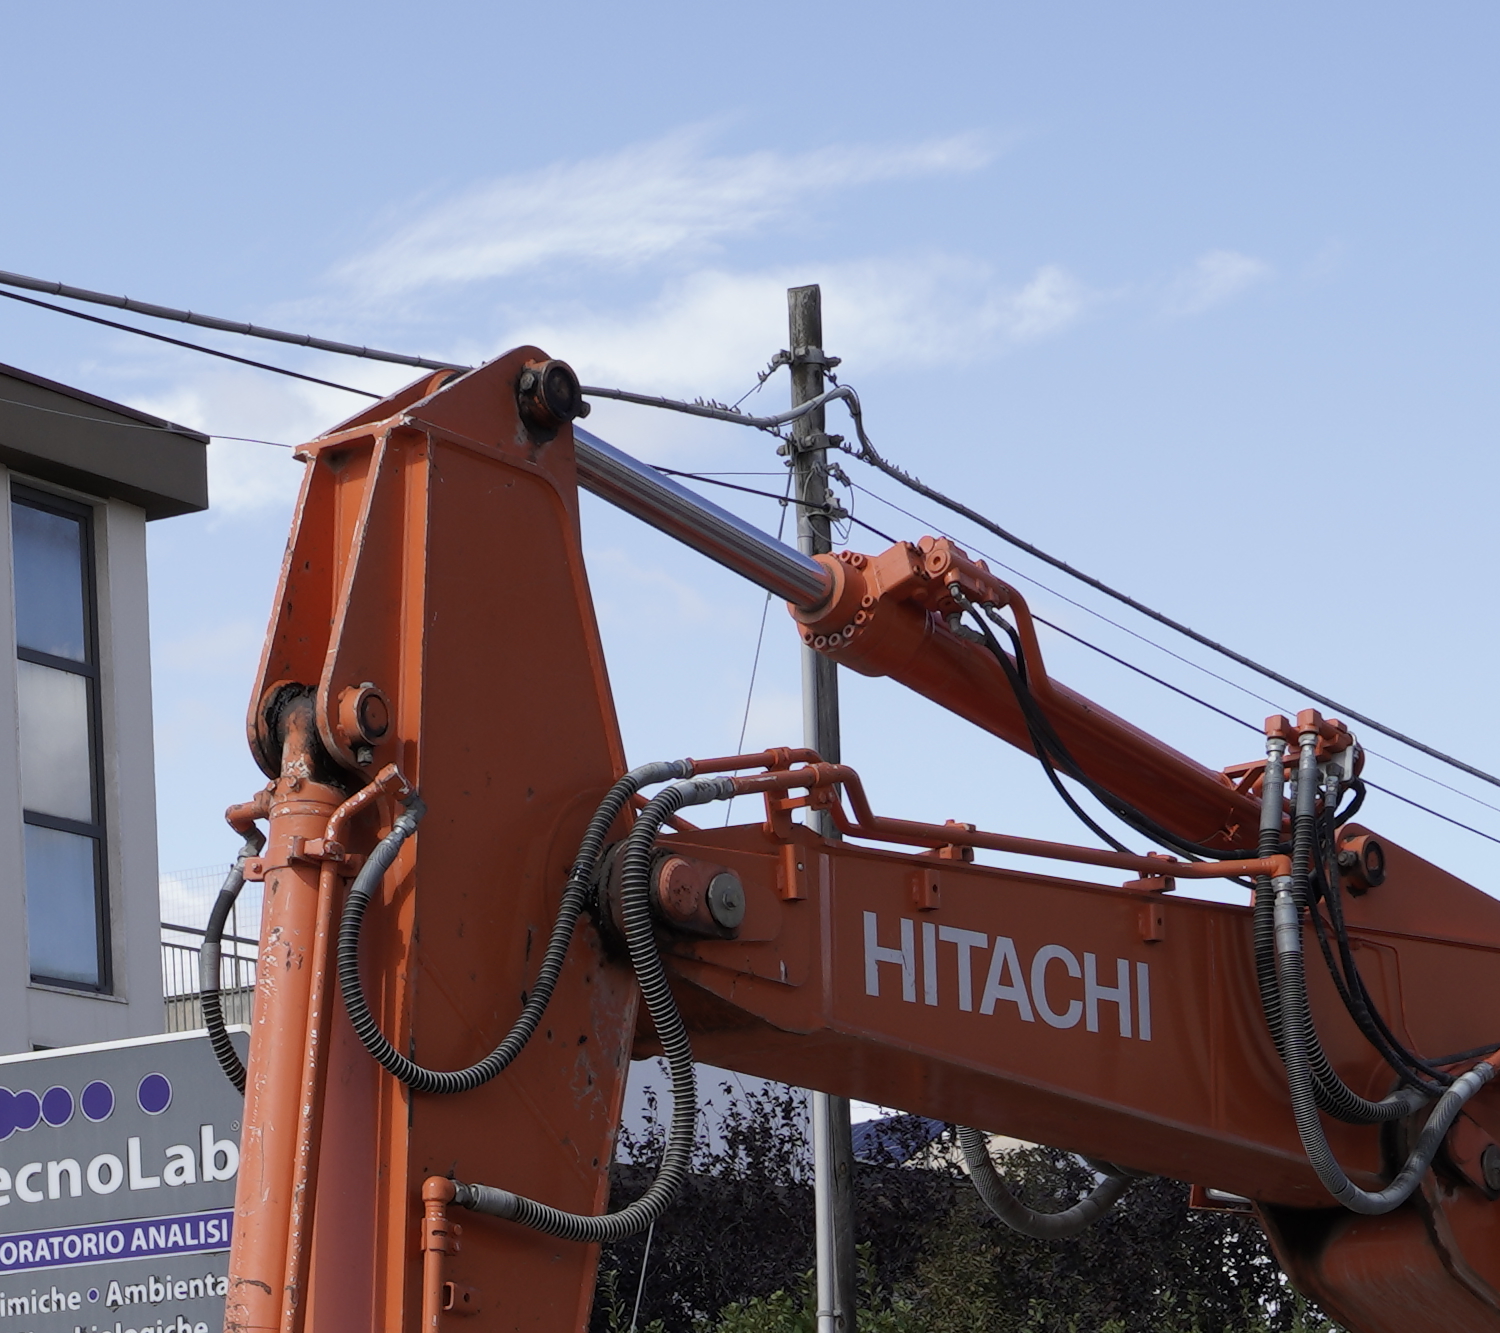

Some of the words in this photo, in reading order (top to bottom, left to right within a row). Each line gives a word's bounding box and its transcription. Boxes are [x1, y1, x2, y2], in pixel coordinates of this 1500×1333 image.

[862, 910, 1152, 1041] HITACHI
[130, 1218, 229, 1252] ANALISI
[104, 1274, 230, 1308] Ambienta
